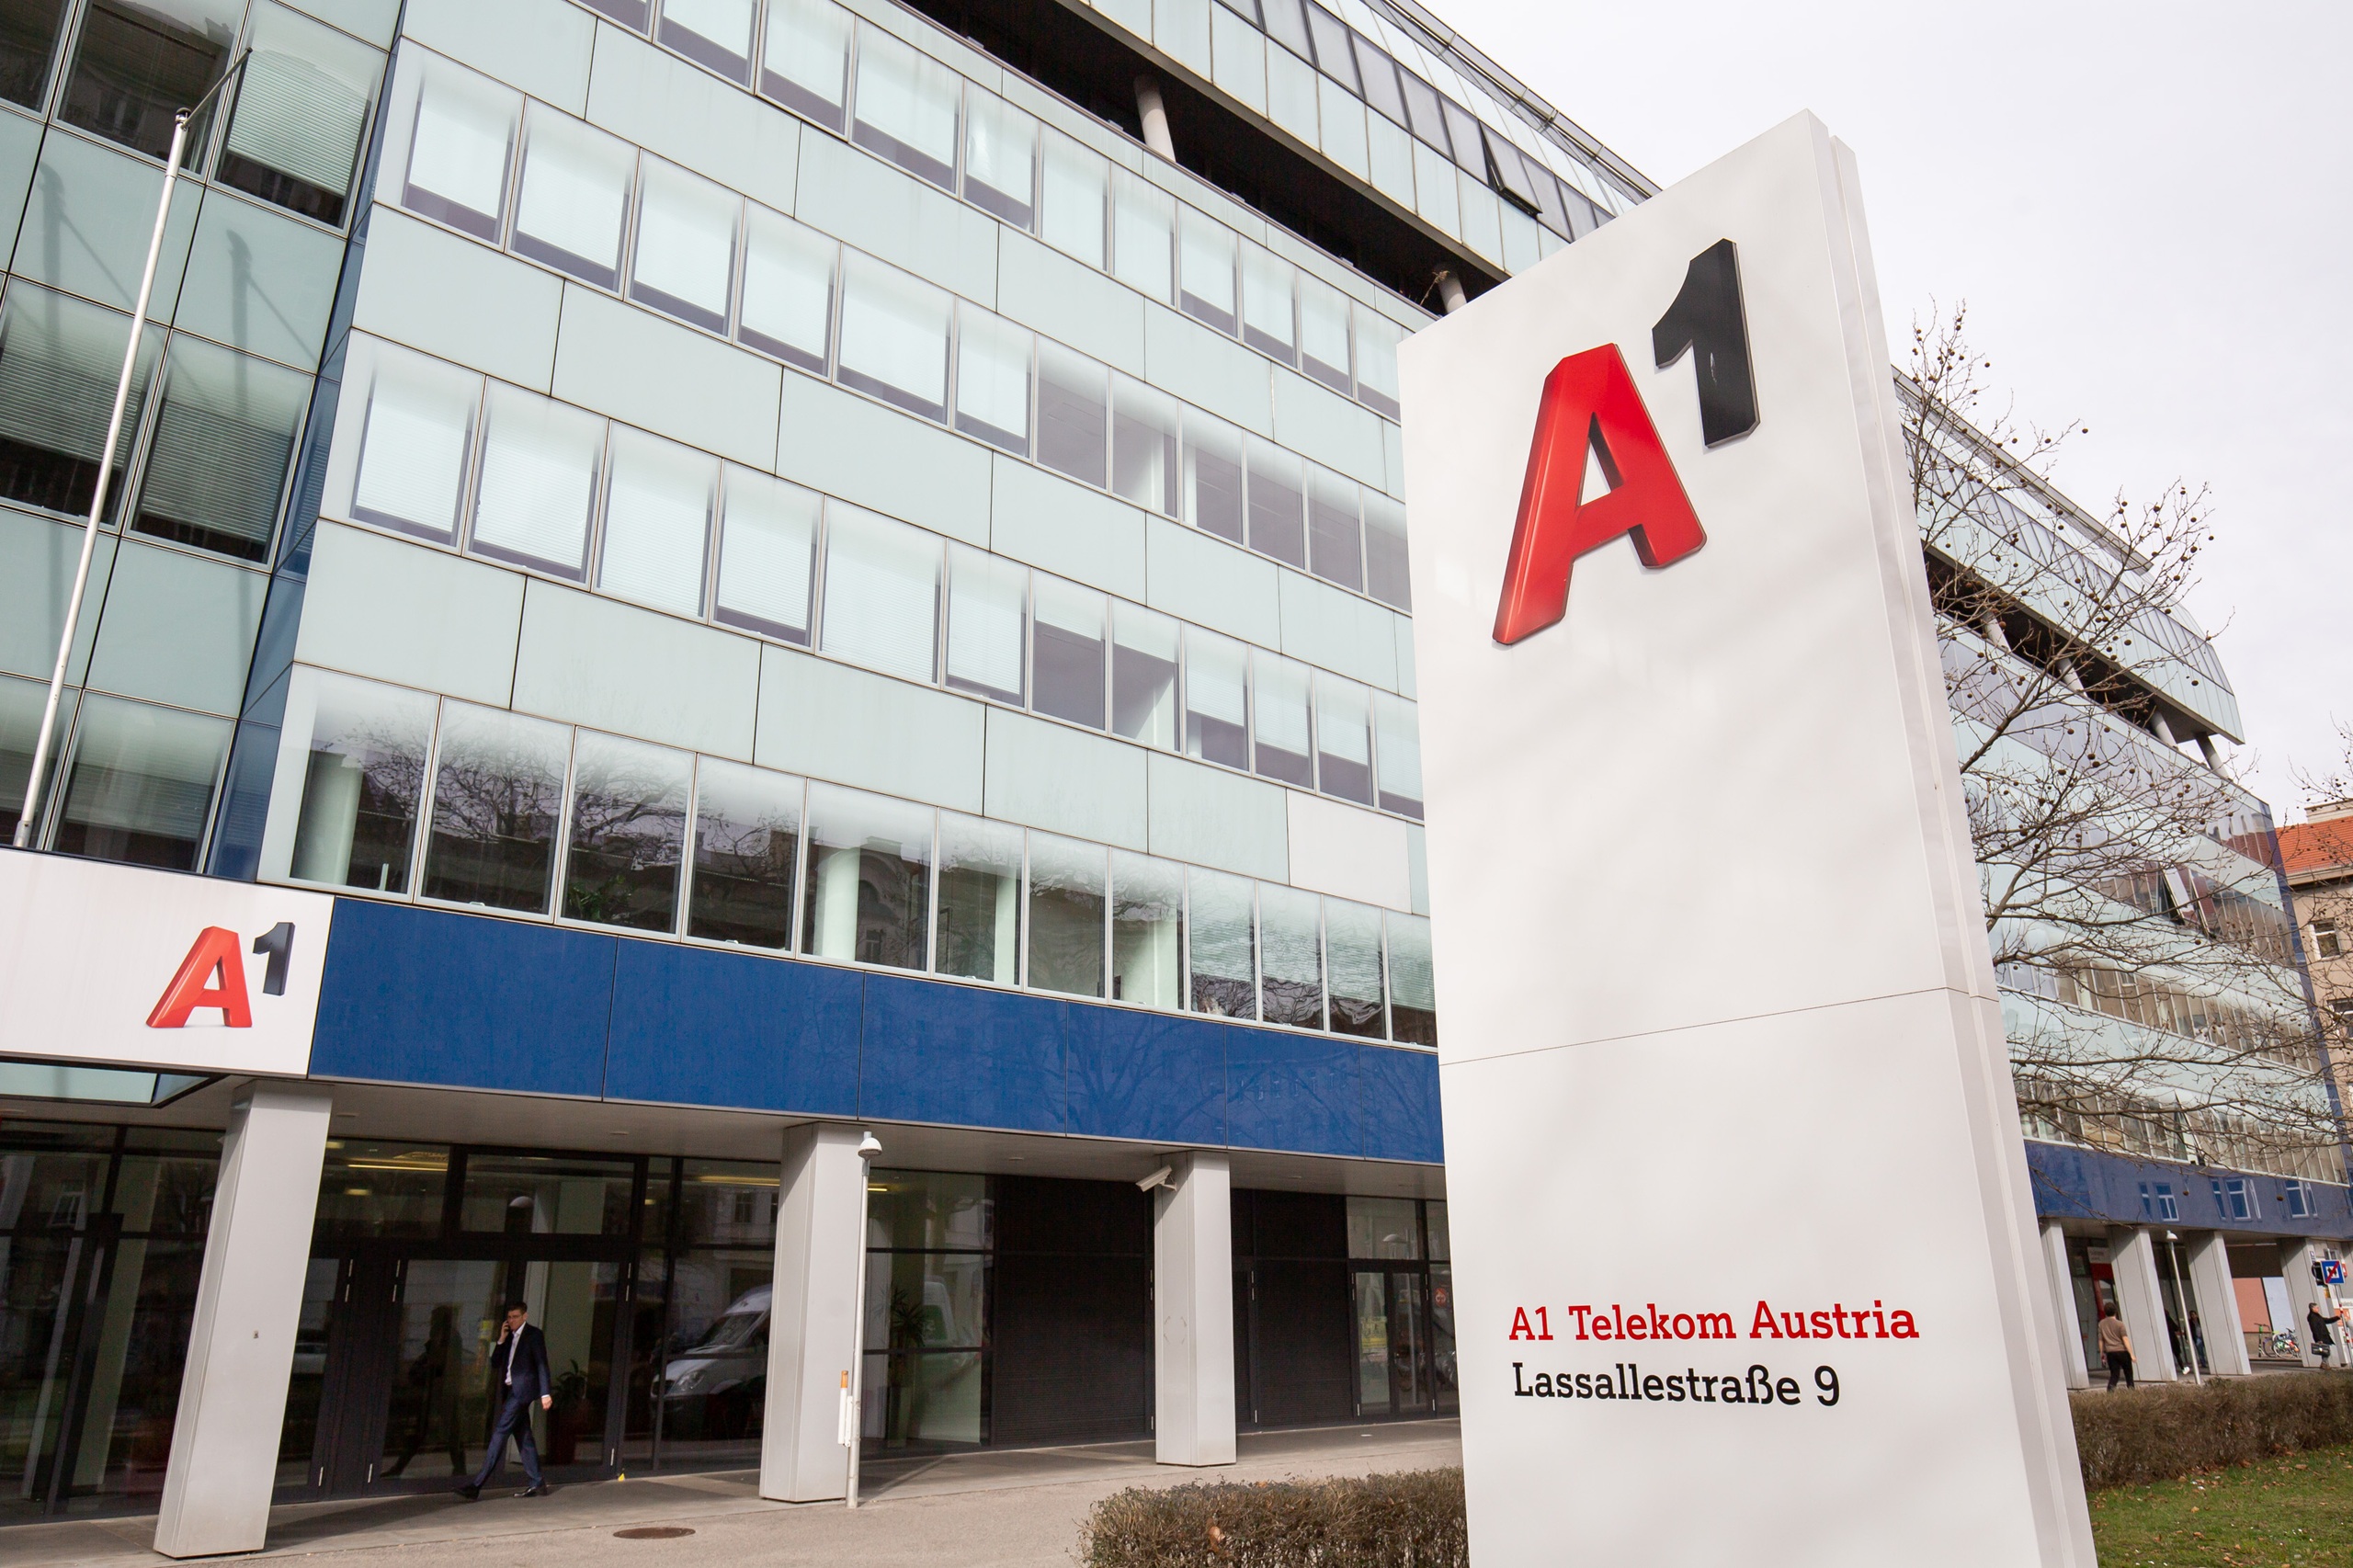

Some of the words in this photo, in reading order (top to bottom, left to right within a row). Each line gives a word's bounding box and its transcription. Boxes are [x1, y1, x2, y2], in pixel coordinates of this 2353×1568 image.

[1493, 238, 1760, 645] A1
[146, 922, 295, 1028] A1
[1508, 1306, 1553, 1341] A1
[1568, 1302, 1736, 1341] Telekom
[1749, 1300, 1919, 1340] Austria
[1513, 1362, 1802, 1406] Lassallestraße
[1814, 1366, 1839, 1406] 9
